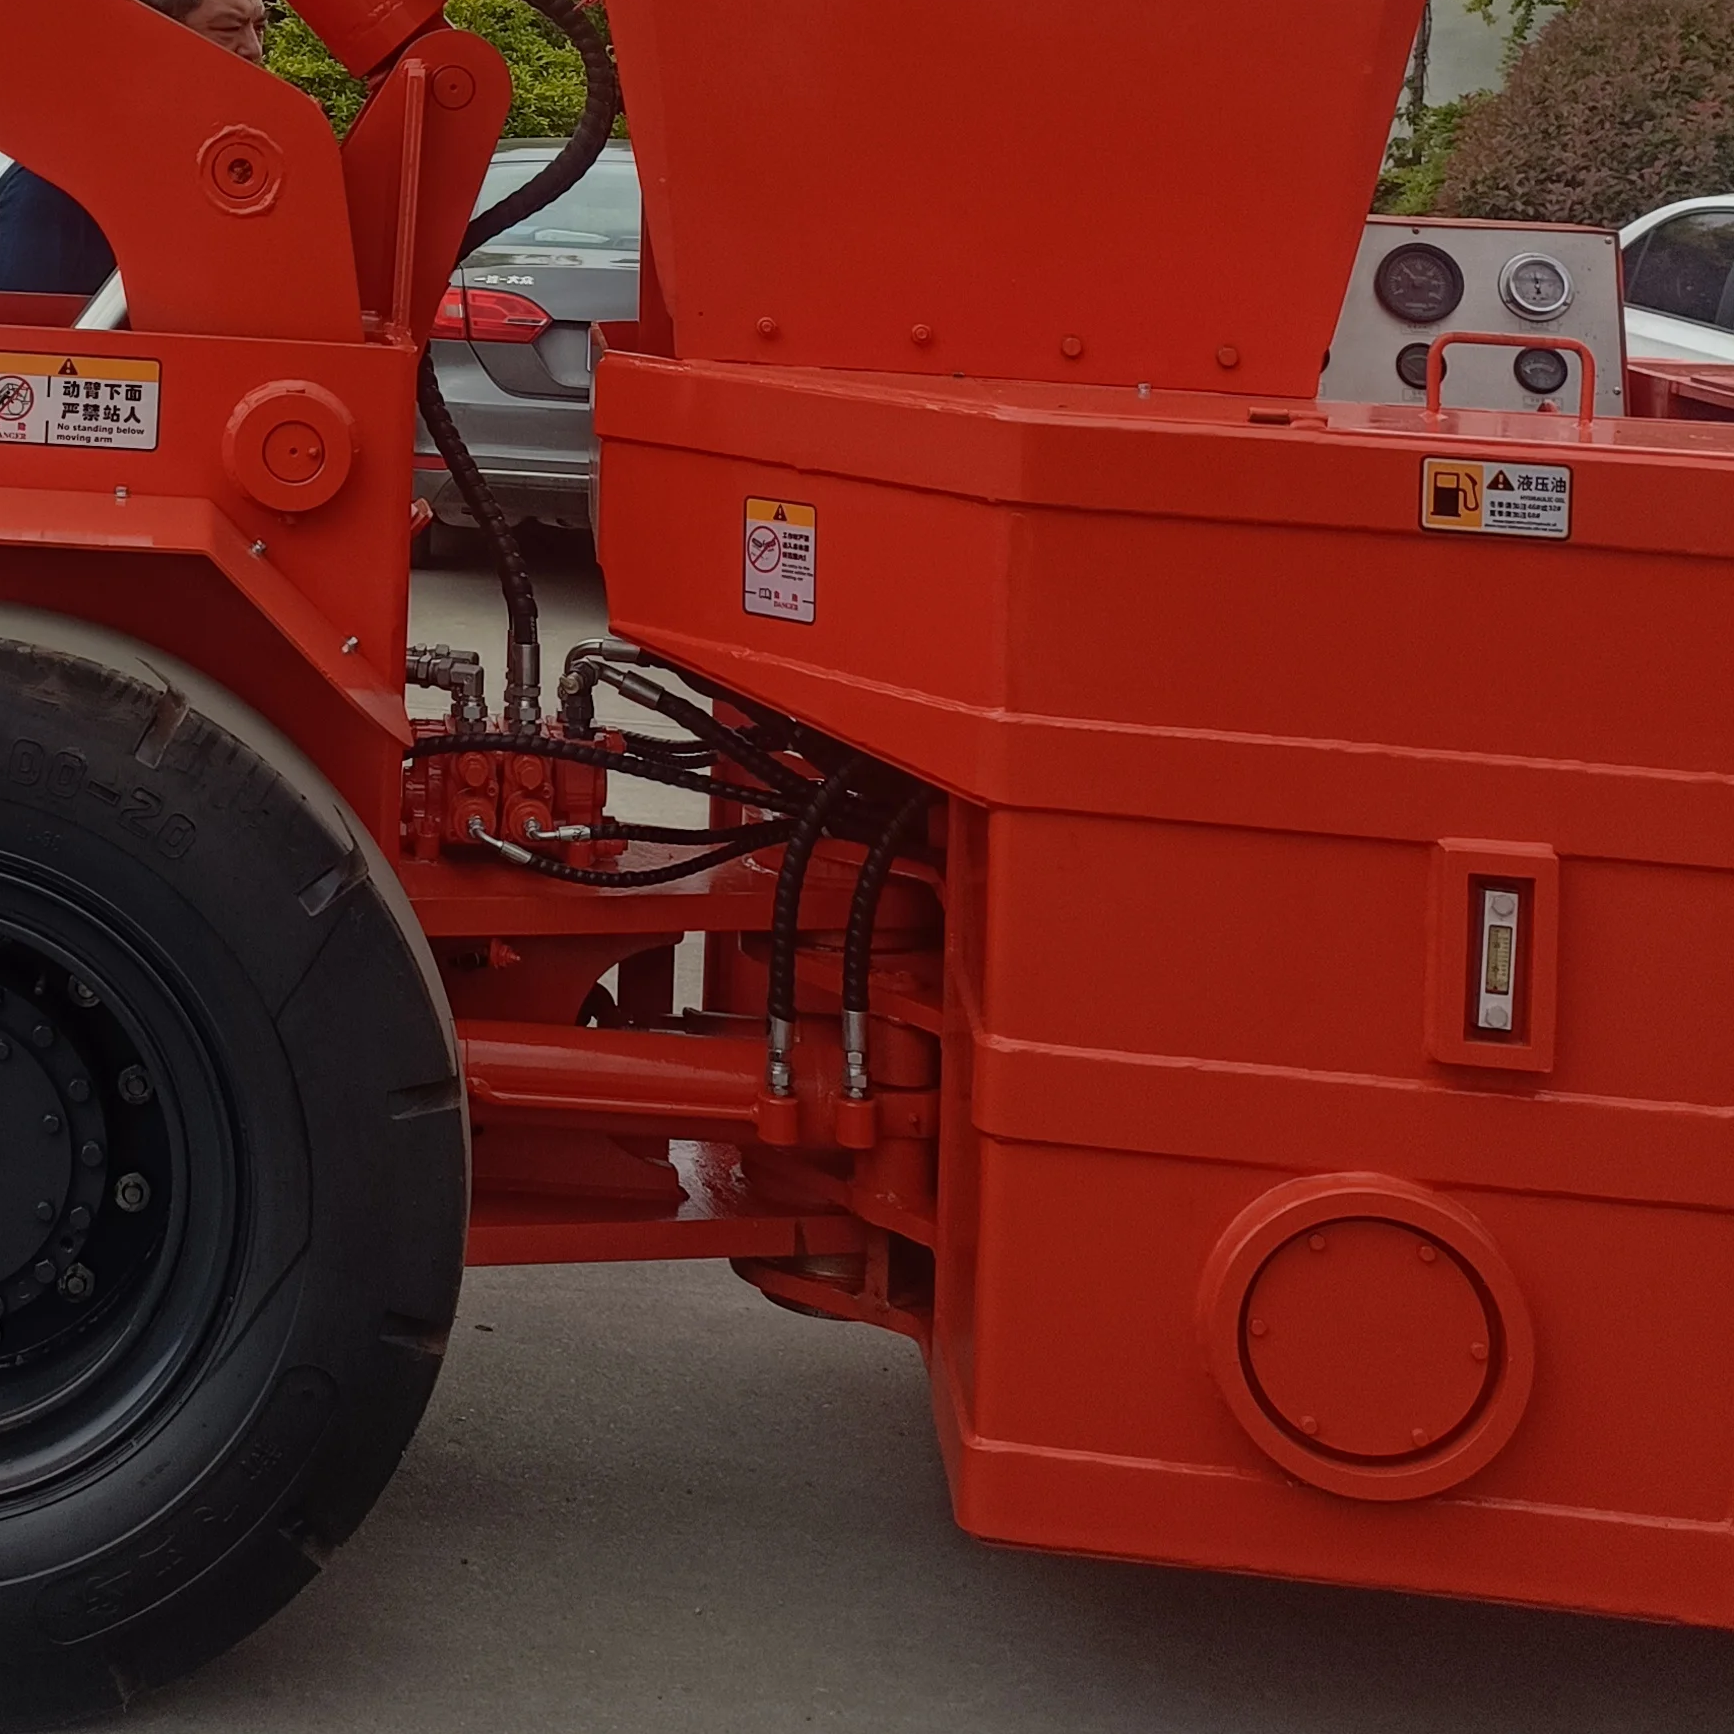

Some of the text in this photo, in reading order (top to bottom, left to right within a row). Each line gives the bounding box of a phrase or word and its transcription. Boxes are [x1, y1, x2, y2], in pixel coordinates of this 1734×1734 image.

[62, 380, 143, 402] 动臂下面
[61, 402, 142, 424] 严禁站人
[56, 433, 91, 443] moving
[57, 423, 145, 435] No standing below
[1516, 474, 1567, 493] 液压油
